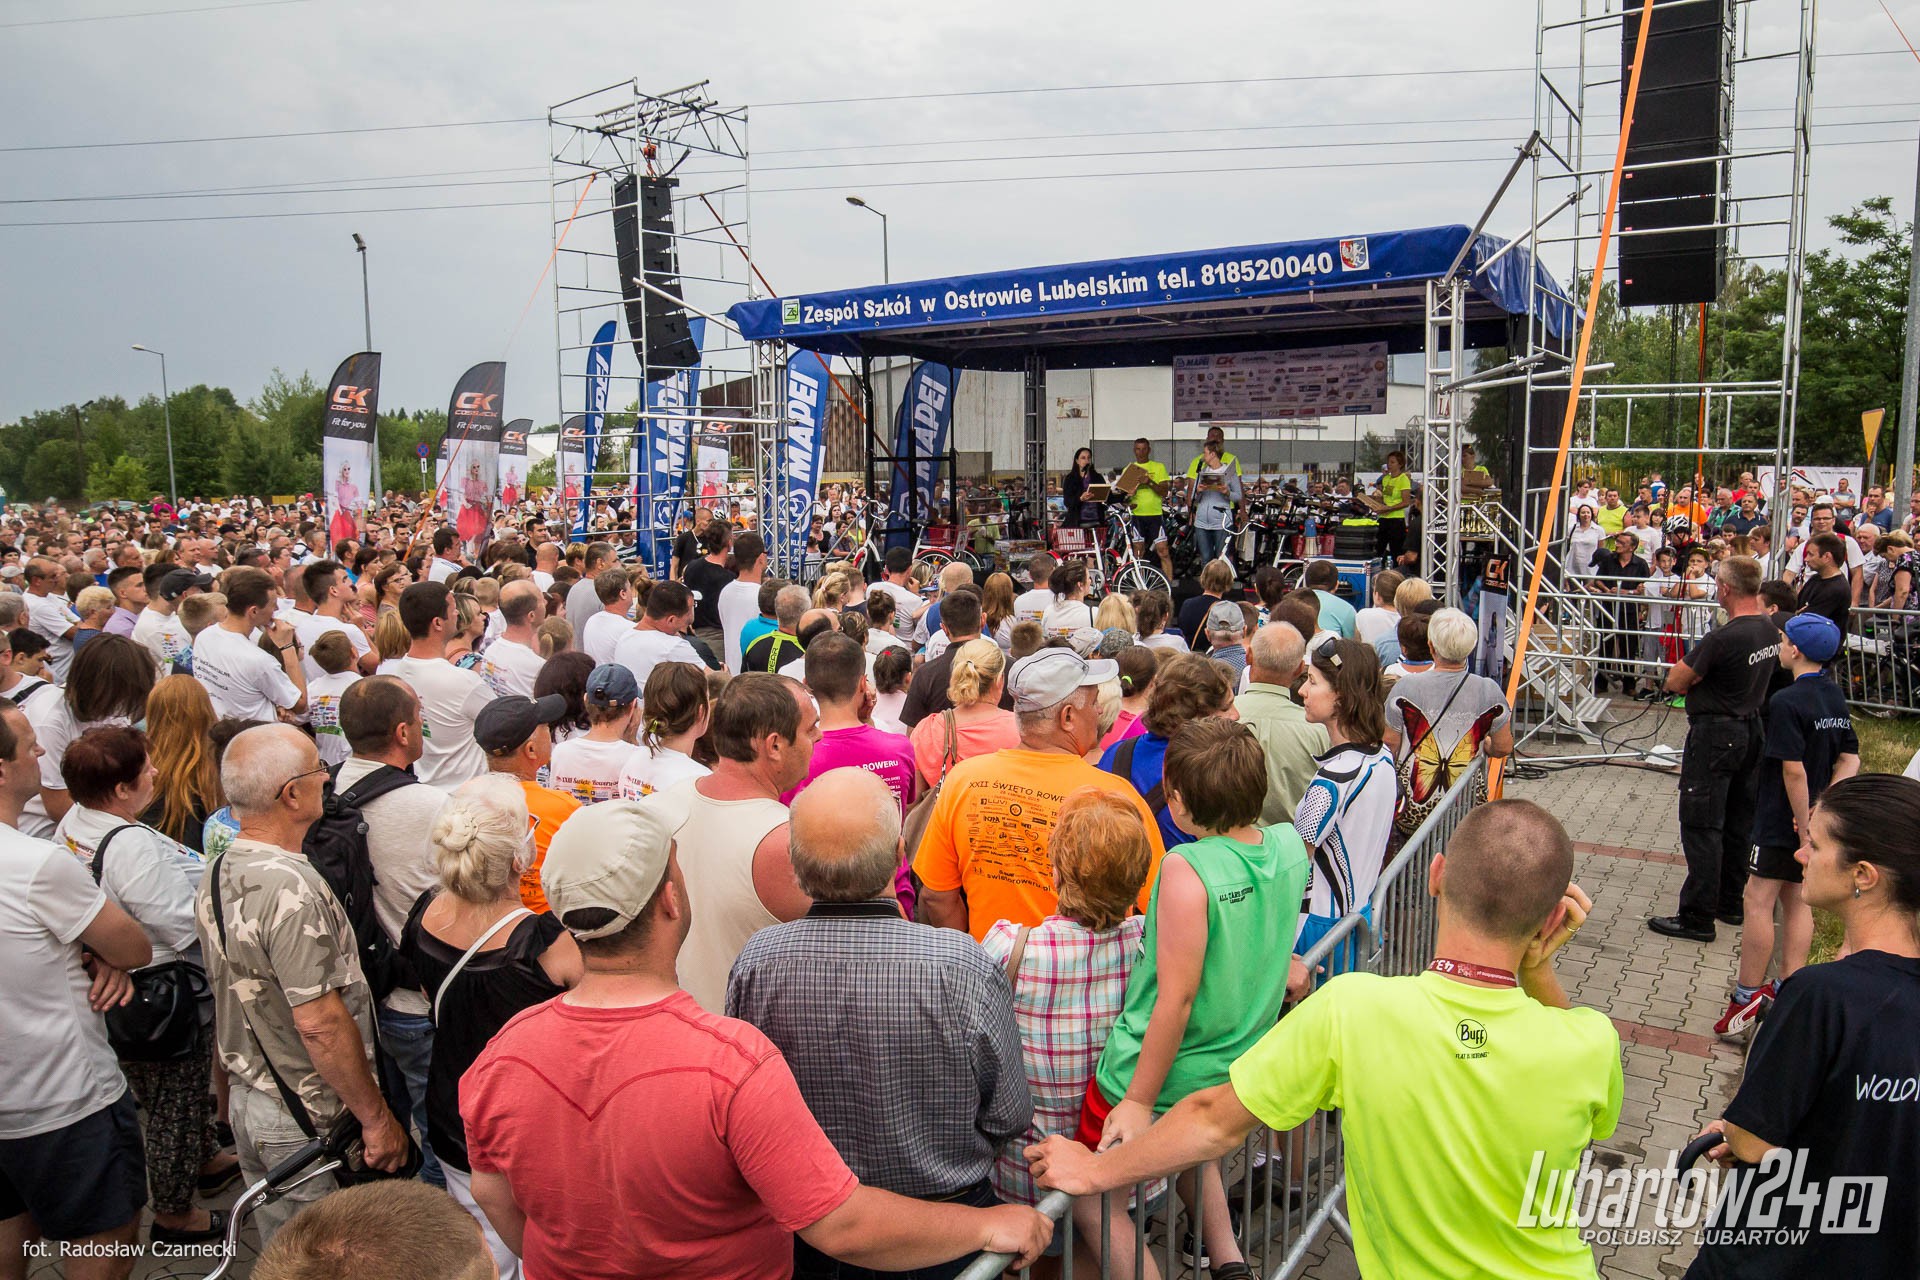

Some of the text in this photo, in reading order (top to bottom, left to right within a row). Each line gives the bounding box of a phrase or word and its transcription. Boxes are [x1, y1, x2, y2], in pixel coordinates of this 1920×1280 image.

[804, 251, 1334, 326] Zespół Szkół w Ostrowie Lubelskim tel. 818520040
[332, 418, 367, 430] Fit for you
[655, 369, 688, 477] MAPE
[788, 371, 820, 483] MAPEI
[915, 374, 948, 483] MAPEI
[1748, 643, 1781, 665] OCHRON
[1036, 790, 1065, 804] ROWE
[1461, 1023, 1485, 1045] Buff
